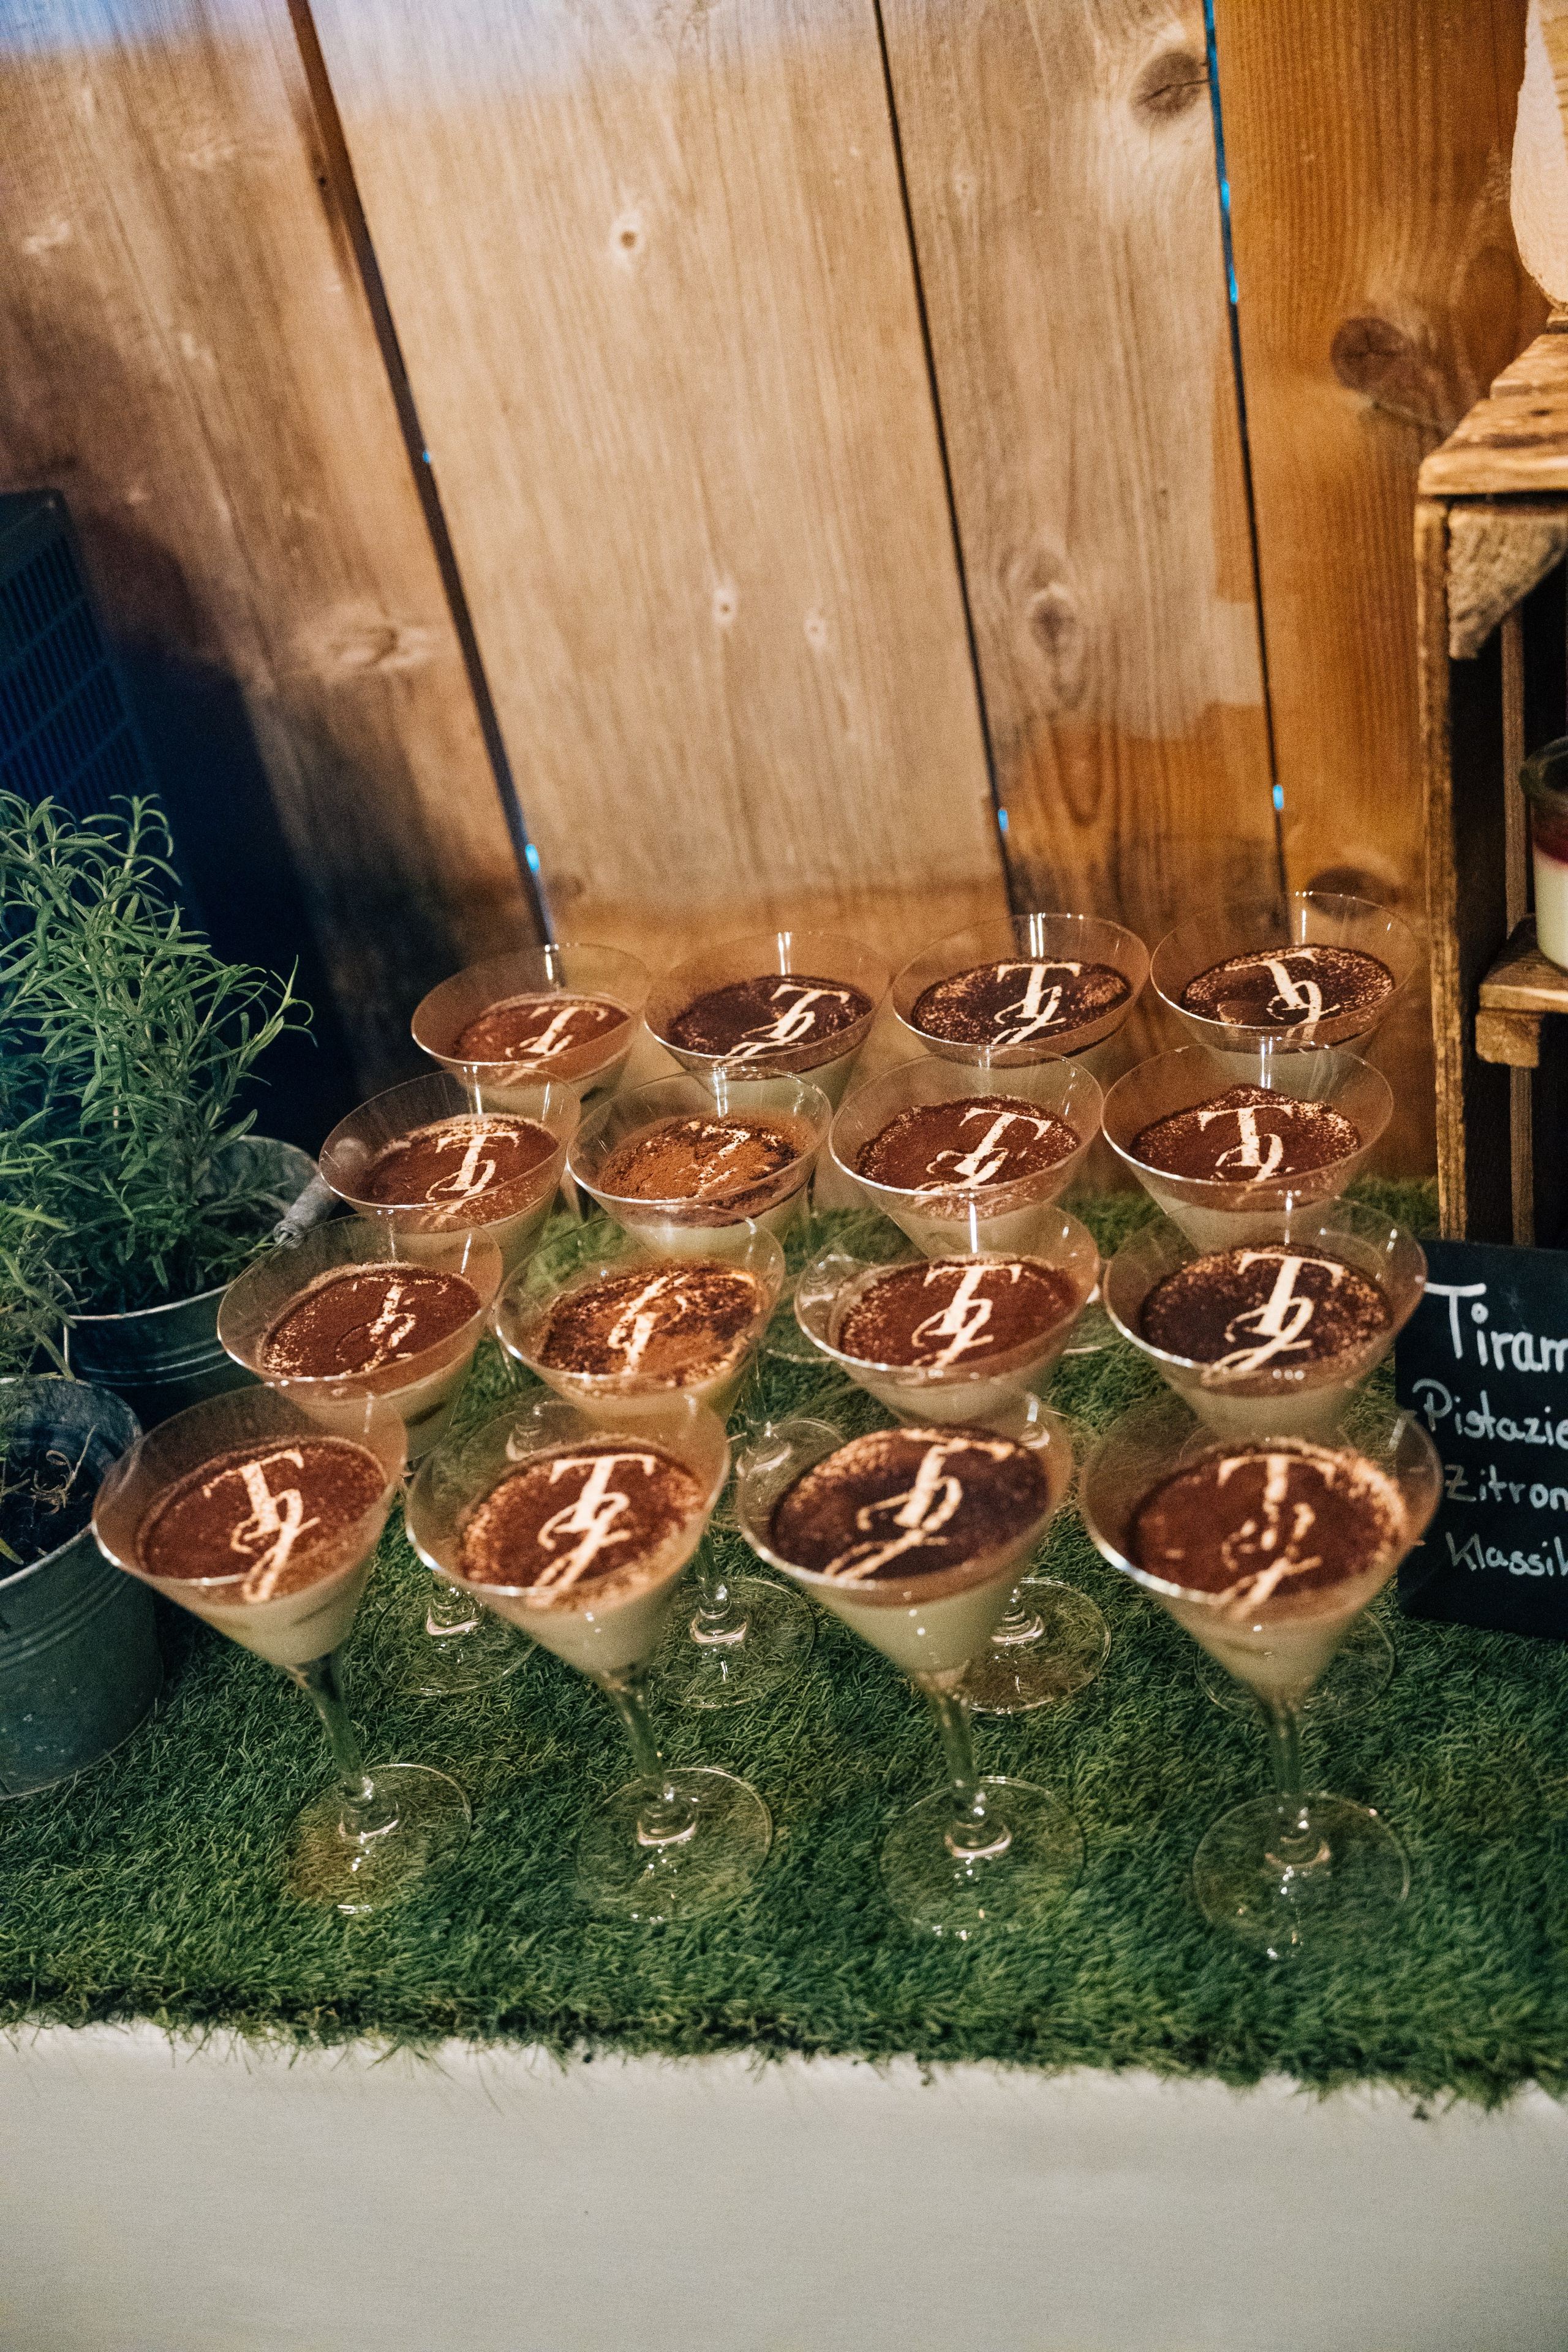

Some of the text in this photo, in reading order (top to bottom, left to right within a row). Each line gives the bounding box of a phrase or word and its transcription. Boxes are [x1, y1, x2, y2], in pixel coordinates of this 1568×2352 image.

[1423, 1283, 1568, 1373] Tiram
[1412, 1378, 1568, 1449] Pistazie
[1444, 1464, 1568, 1510] Zitron
